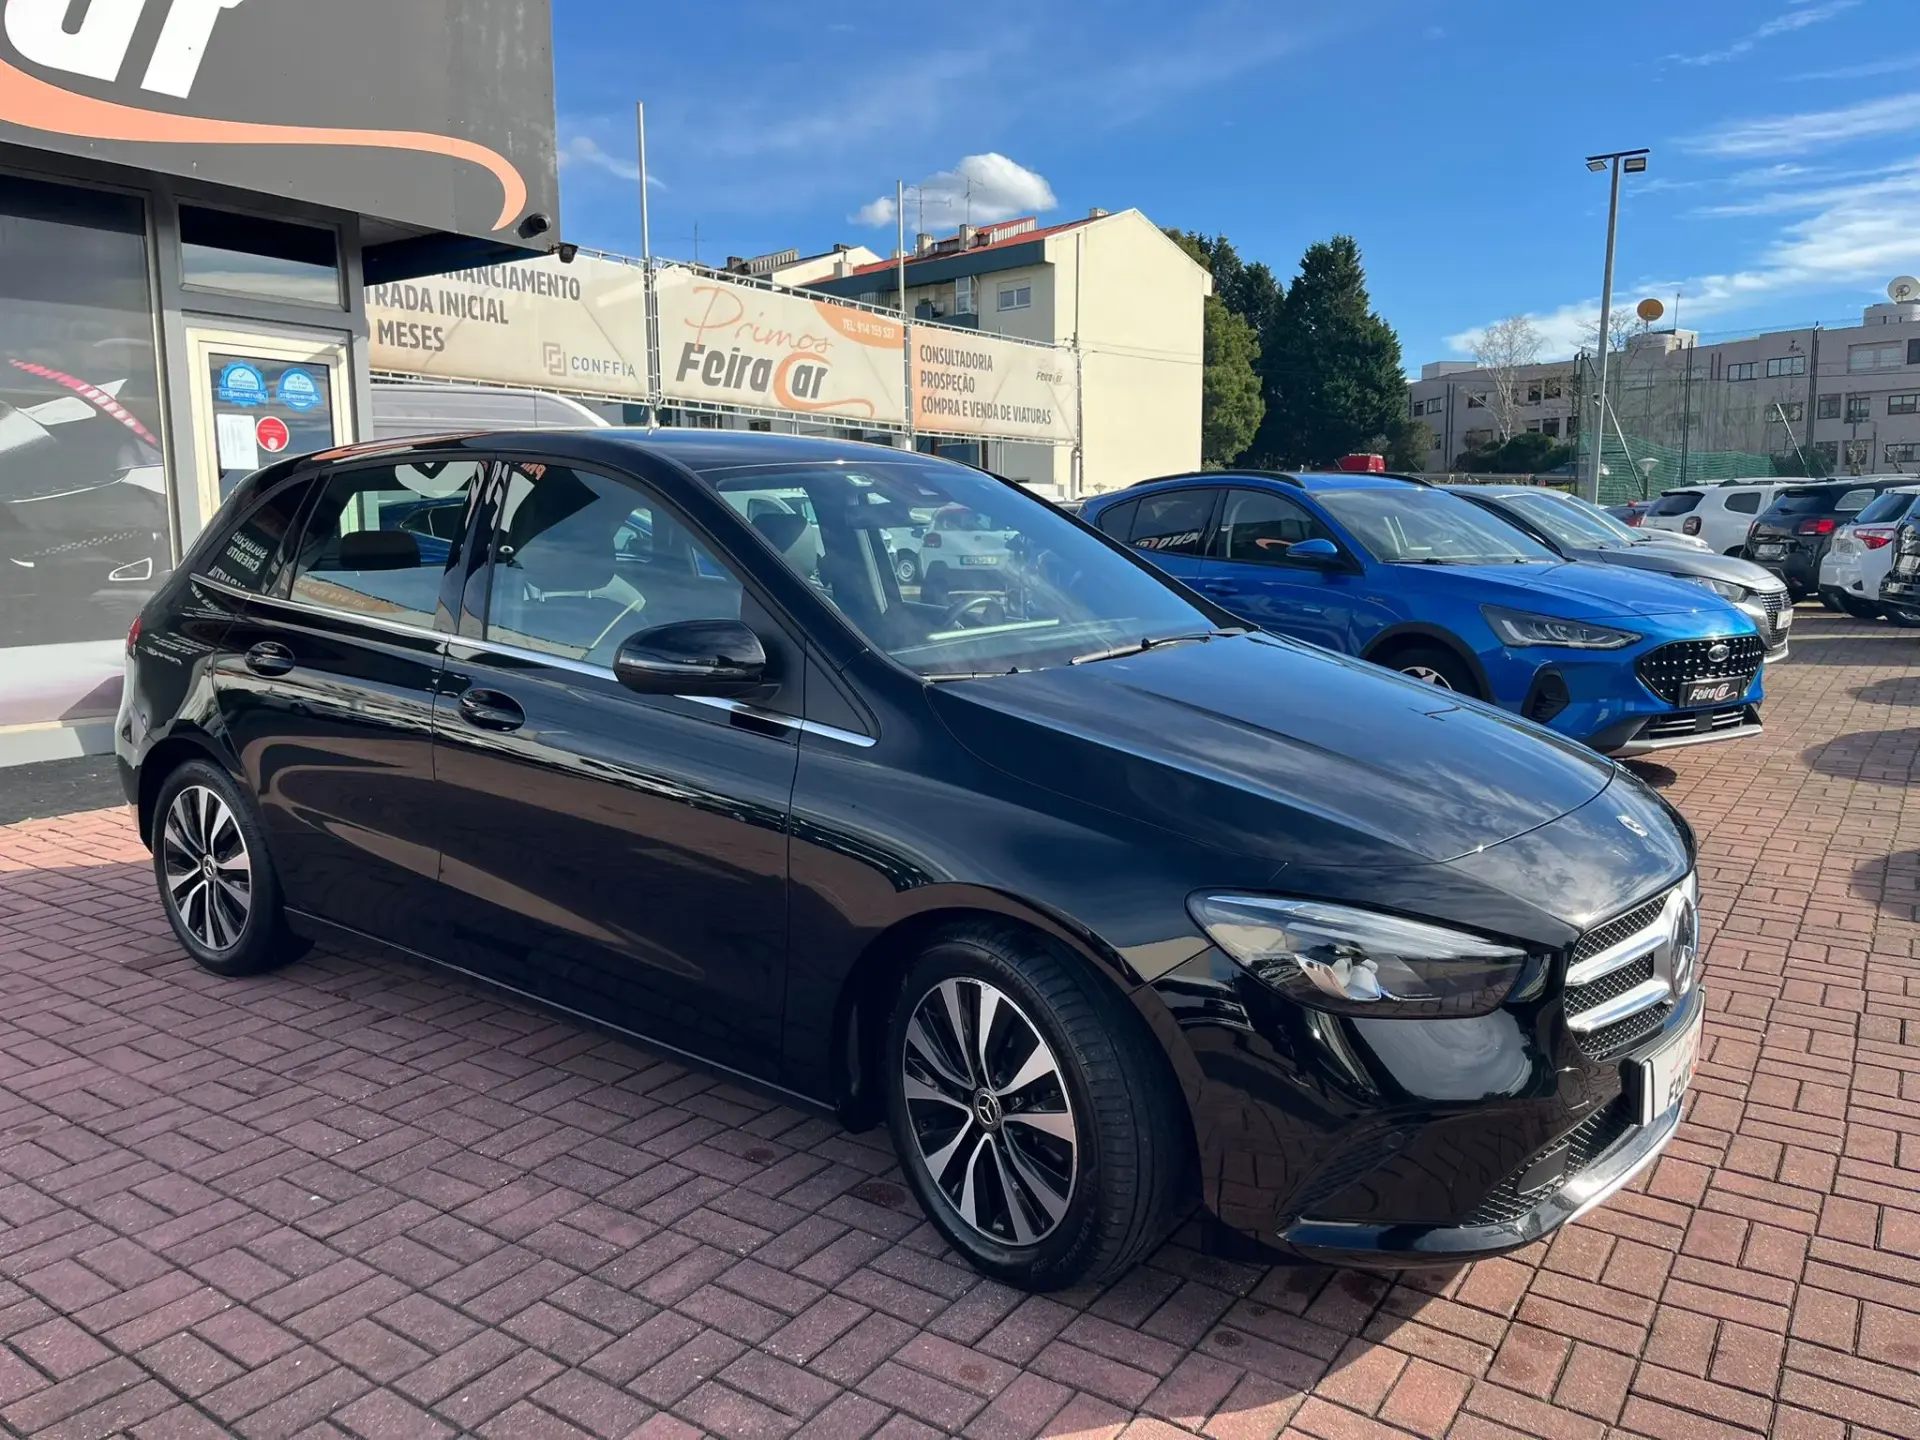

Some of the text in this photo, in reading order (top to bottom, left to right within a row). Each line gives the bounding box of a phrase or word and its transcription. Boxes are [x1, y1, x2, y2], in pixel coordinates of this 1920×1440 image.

[439, 289, 509, 325] INICIAL
[684, 286, 833, 354] Primos
[376, 318, 445, 352] MESES
[571, 356, 636, 377] CONFFIA
[919, 344, 993, 372] CONSULTADORIA
[920, 370, 975, 395] PROSPEÇÃO
[921, 395, 1052, 425] COMPRA E VENDA DE VIATURAS
